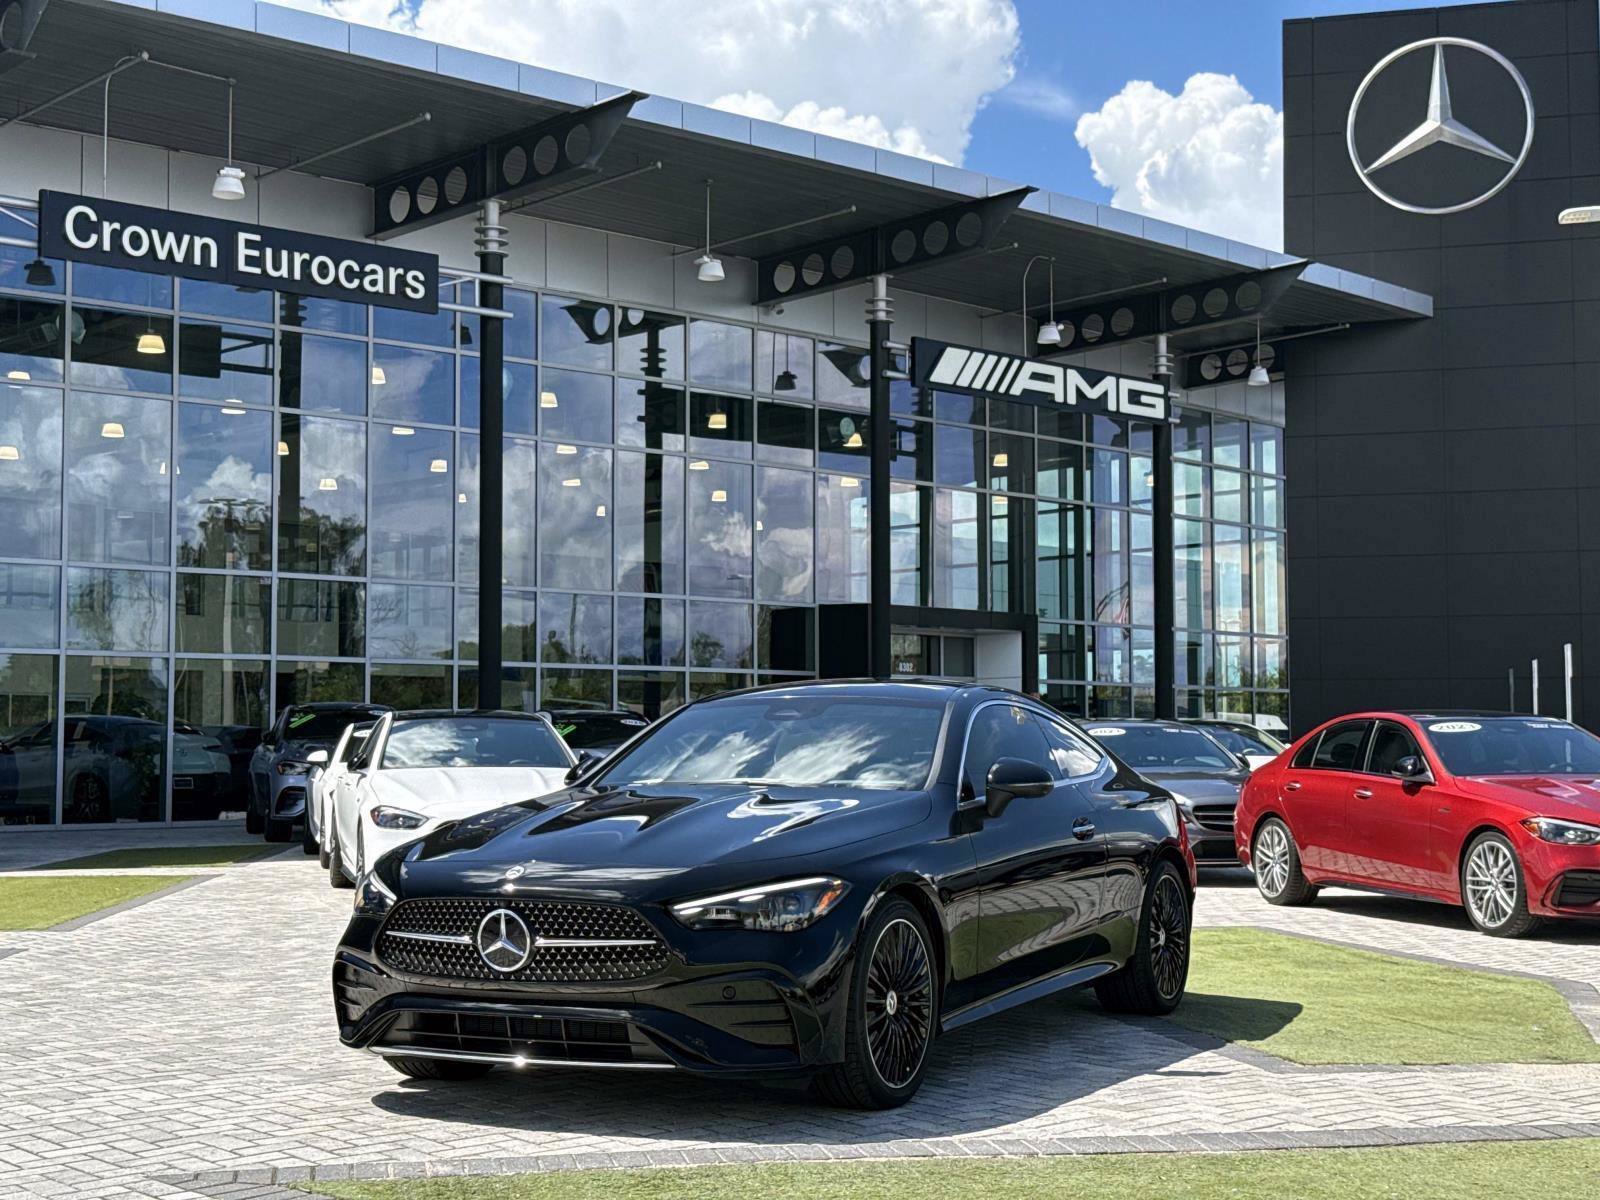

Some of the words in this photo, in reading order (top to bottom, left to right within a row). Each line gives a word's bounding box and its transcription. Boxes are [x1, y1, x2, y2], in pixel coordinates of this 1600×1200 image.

[64, 205, 218, 268] Crown
[237, 231, 426, 299] Eurocars
[1009, 360, 1165, 420] AMG
